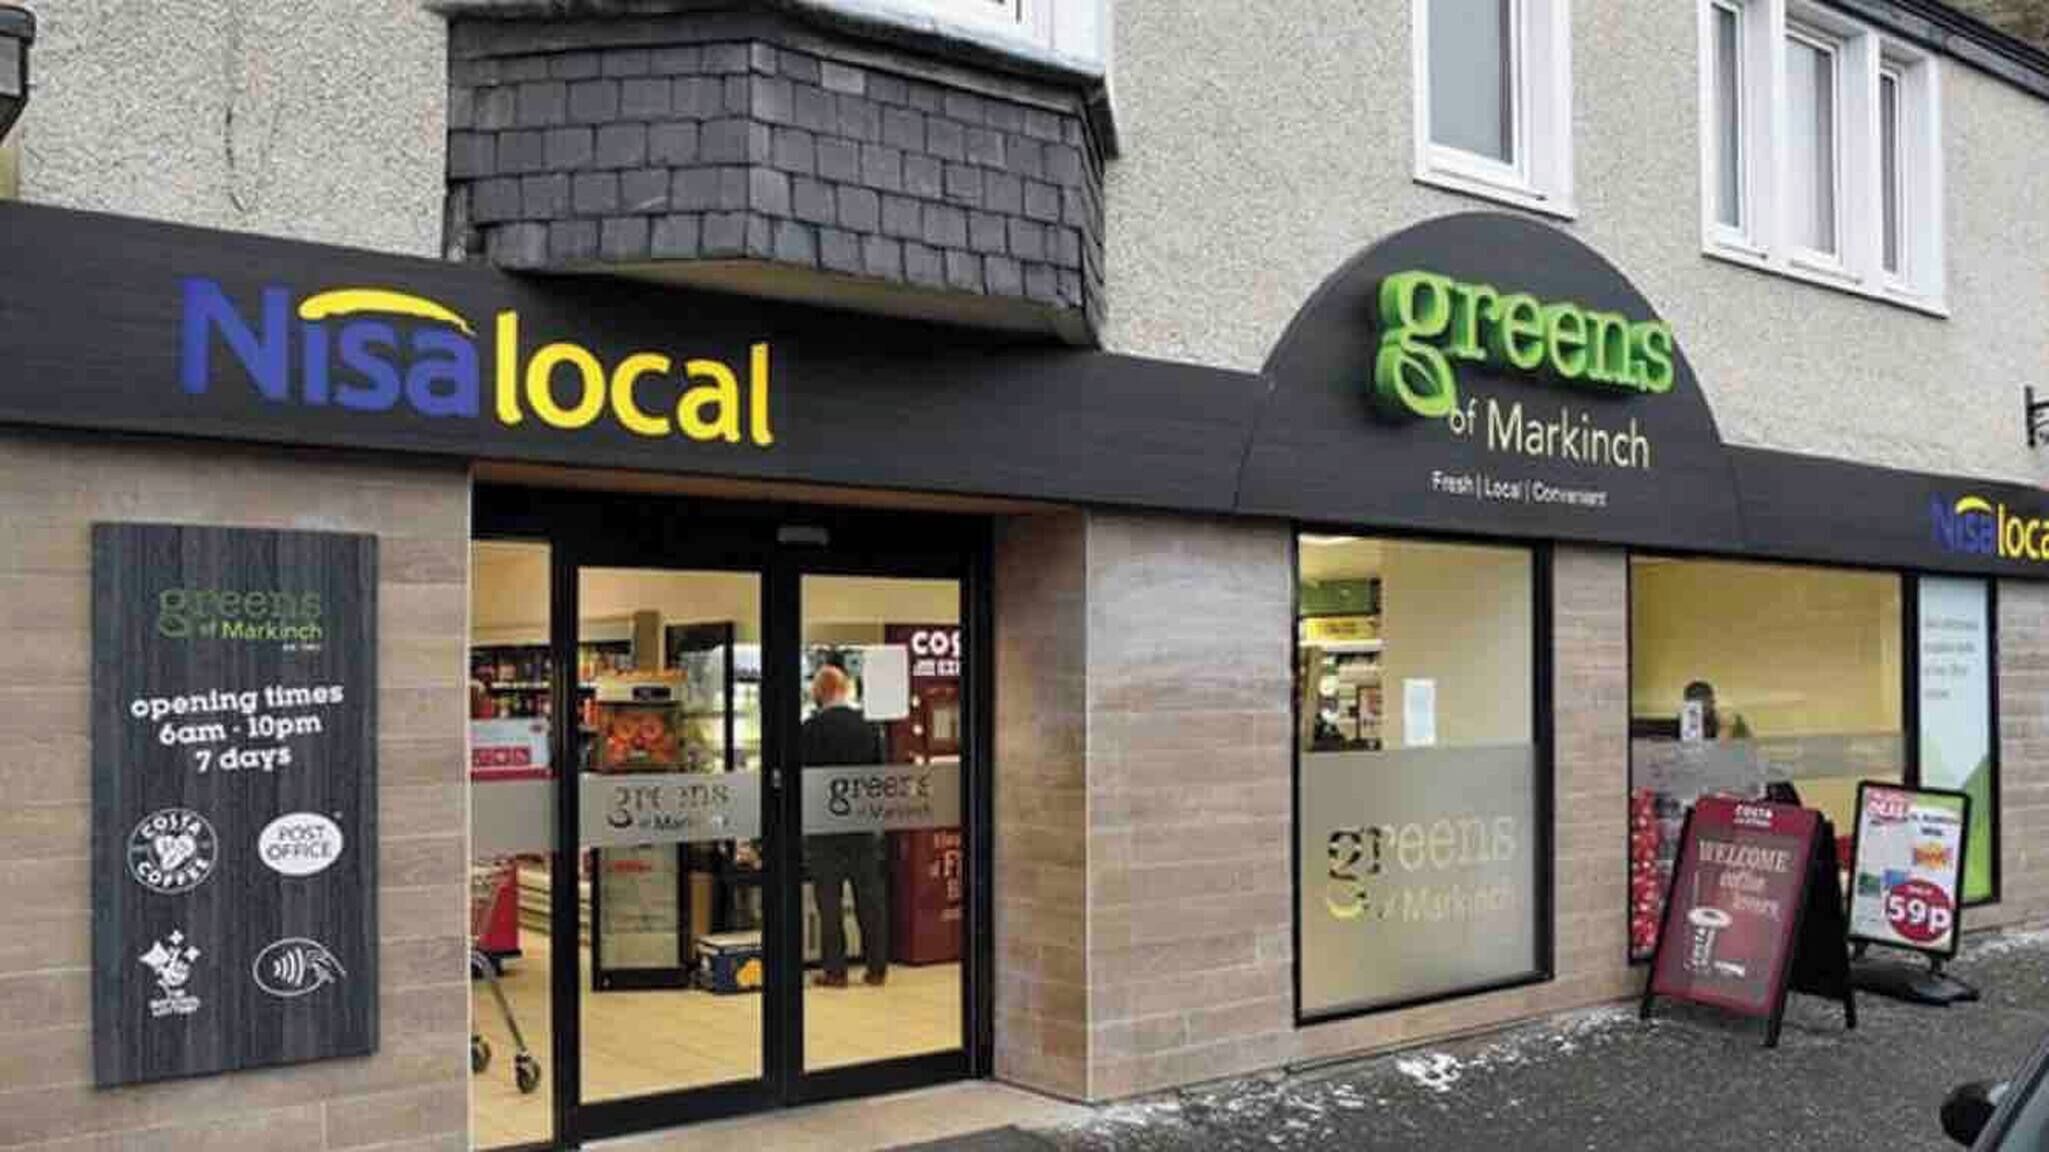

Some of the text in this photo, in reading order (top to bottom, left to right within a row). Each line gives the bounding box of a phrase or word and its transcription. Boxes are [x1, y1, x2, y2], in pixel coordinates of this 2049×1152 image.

[1375, 269, 1676, 419] greens
[176, 277, 774, 447] Nisa local
[1450, 399, 1650, 470] of Markinch
[1484, 475, 1523, 499] Local
[1931, 495, 1995, 553] Nisa
[158, 589, 321, 638] greens
[220, 621, 323, 640] Markinch
[131, 684, 344, 721] opening times
[159, 721, 226, 745] 6am
[247, 714, 322, 740] 10pm
[195, 747, 292, 773] 7 days
[141, 813, 201, 839] COSTA
[279, 825, 325, 841] POST
[266, 842, 332, 861] OFFICE
[1699, 839, 1794, 873] WELCOME
[137, 858, 209, 888] COFFEE
[1887, 896, 1952, 935] 59p
